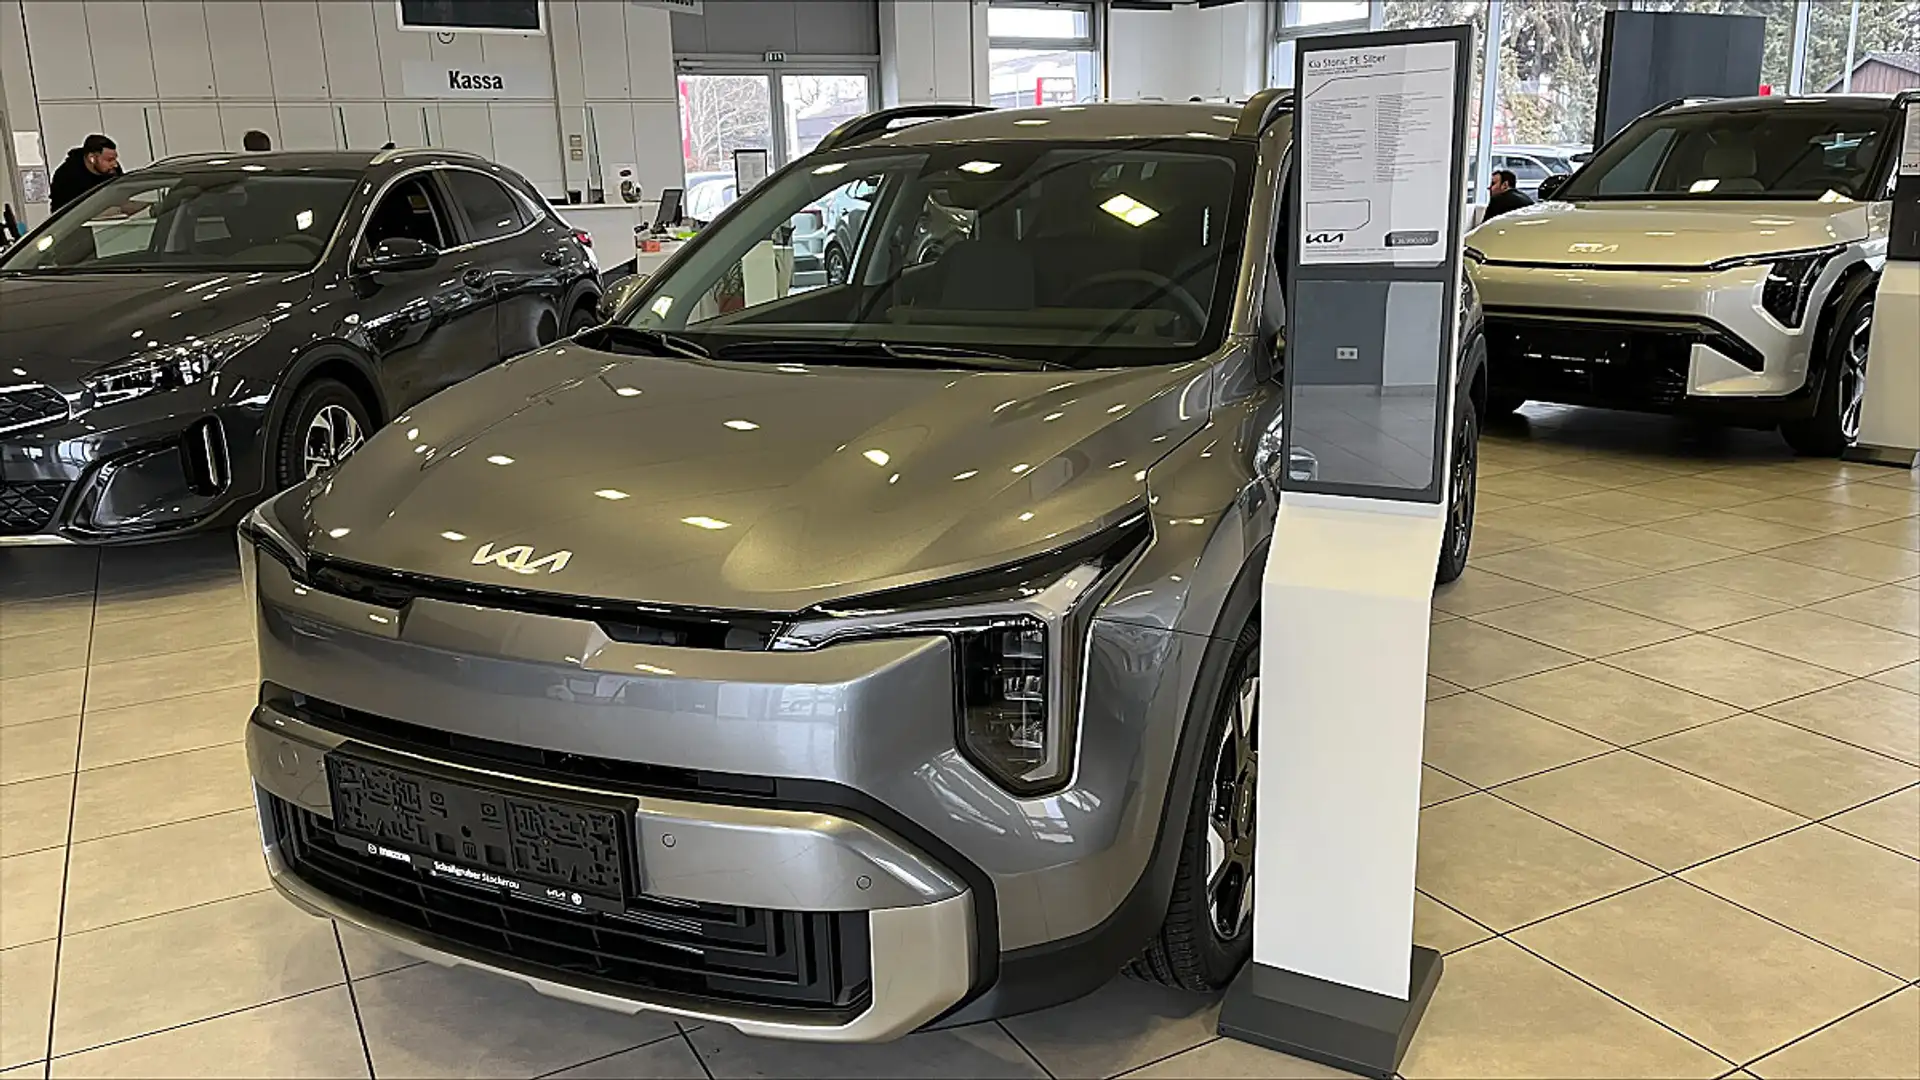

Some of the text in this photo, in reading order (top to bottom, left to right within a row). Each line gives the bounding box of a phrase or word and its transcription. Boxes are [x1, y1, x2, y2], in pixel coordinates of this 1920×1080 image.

[1308, 59, 1321, 68] Kia
[1323, 58, 1347, 68] Stonic
[448, 70, 504, 89] Kassa
[1305, 232, 1344, 244] KIA
[1567, 243, 1619, 253] KIA
[471, 542, 573, 575] KIA
